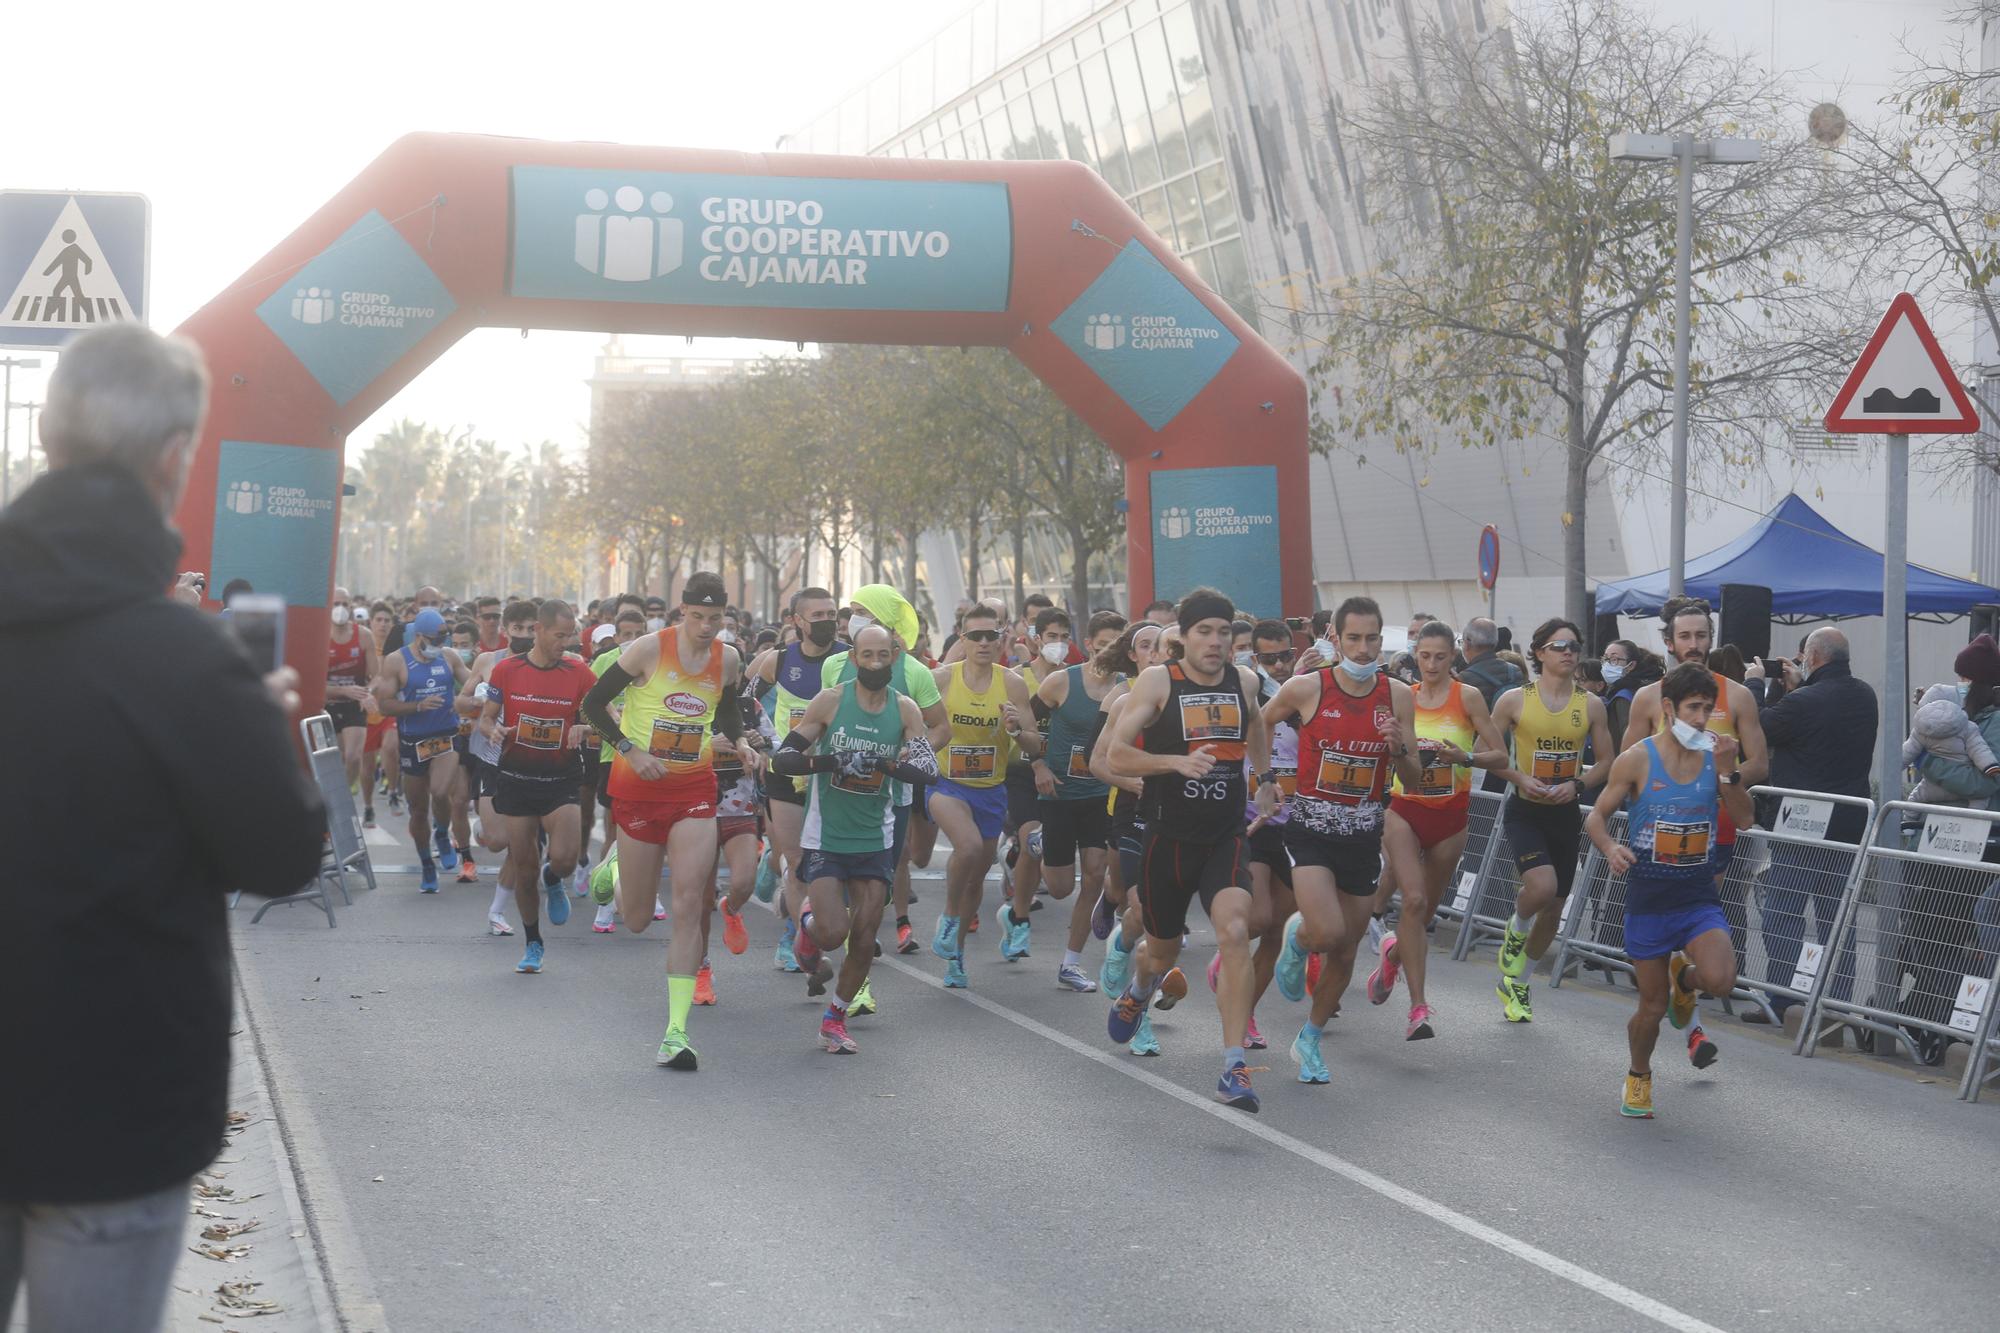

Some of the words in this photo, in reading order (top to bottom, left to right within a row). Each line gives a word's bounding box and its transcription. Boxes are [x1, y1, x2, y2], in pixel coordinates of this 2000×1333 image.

[700, 197, 823, 226] GRUPO
[701, 225, 950, 258] COOPERATIVO
[700, 255, 868, 289] CAJAMAR
[341, 291, 390, 305] GRUPO
[341, 303, 435, 319] COOPERATIVO
[340, 314, 404, 328] CAJAMAR
[1131, 316, 1176, 327] GRUPO
[1131, 327, 1219, 339] COOPERATIVO
[1131, 338, 1194, 350] CAJAMAR
[268, 486, 306, 498] GRUPO
[267, 506, 316, 518] CAJAMAR
[1195, 507, 1235, 518] GRUPO
[1195, 515, 1272, 527] COOPERATIVO
[1196, 526, 1249, 537] CAJAMAR
[668, 697, 704, 712] Serrano
[1205, 705, 1221, 720] 14
[675, 734, 683, 747] 7
[830, 734, 878, 754] ALEJANDRO
[1318, 739, 1344, 751] C.A.
[965, 756, 980, 767] 65
[1553, 762, 1561, 774] 6
[1344, 767, 1355, 781] 11
[1680, 835, 1688, 851] 4
